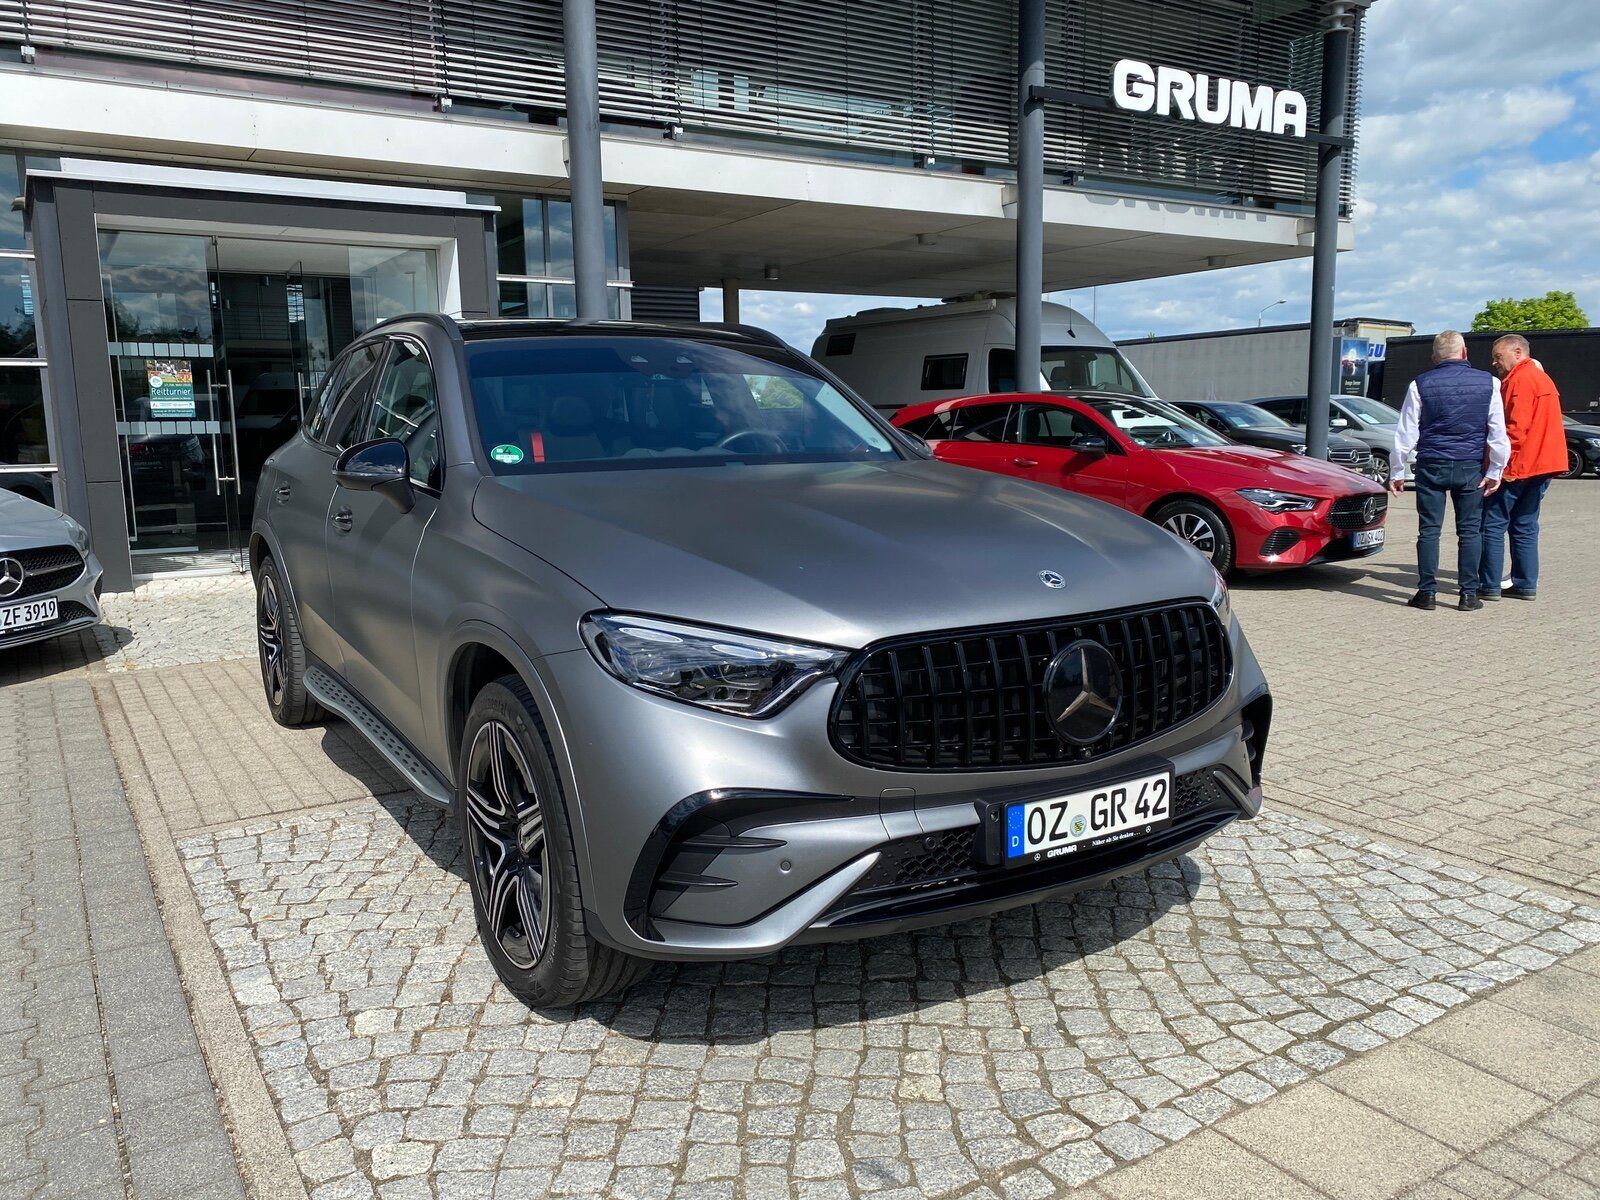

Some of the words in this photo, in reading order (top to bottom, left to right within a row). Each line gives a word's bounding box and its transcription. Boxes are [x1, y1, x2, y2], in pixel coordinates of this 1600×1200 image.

[1112, 58, 1307, 138] GRUMA
[151, 387, 191, 396] Reitturnier
[2, 607, 21, 626] ZF
[24, 600, 56, 622] 3919
[1011, 835, 1020, 847] D
[1027, 801, 1068, 845] OZ
[1090, 787, 1127, 831] GR
[1134, 778, 1168, 820] 42
[1047, 844, 1077, 858] GRUMA
